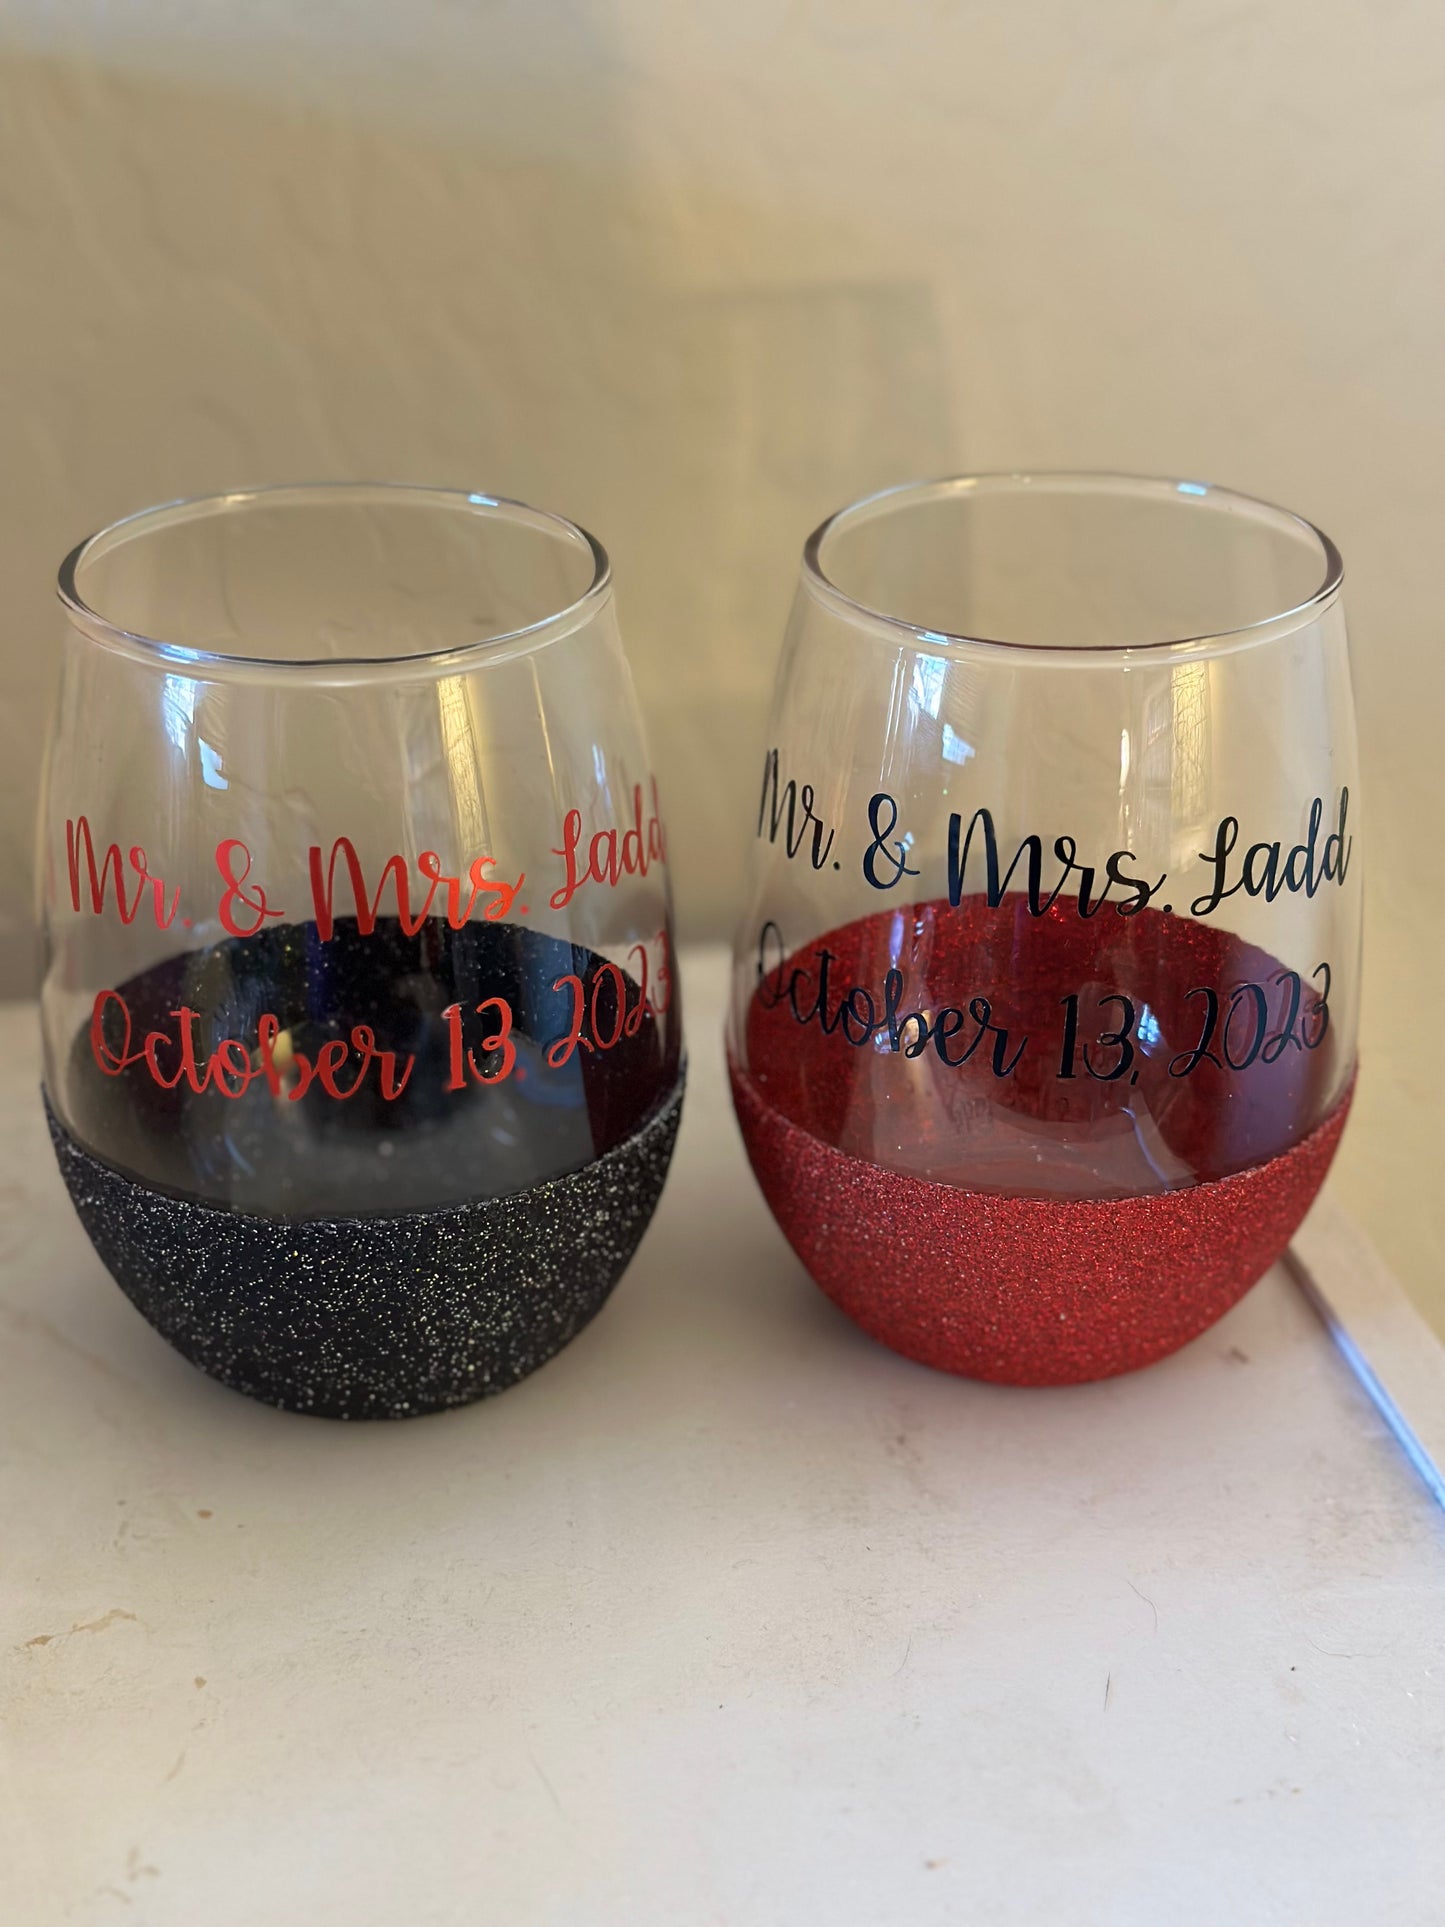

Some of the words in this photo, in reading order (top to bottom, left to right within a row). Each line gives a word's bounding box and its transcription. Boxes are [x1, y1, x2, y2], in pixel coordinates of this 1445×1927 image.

[67, 816, 192, 930] Mr.
[216, 838, 285, 938] &
[308, 836, 529, 942] Mrs.
[550, 773, 666, 910] Ladd
[758, 747, 841, 871] Mr.
[863, 793, 921, 890] &
[947, 808, 1173, 918] Mrs.
[1190, 785, 1353, 917] Ladd
[91, 989, 416, 1101] October
[548, 930, 673, 1068] 2023
[758, 921, 1029, 1078] October
[1056, 994, 1140, 1087] 13,
[1168, 962, 1332, 1079] 2023
